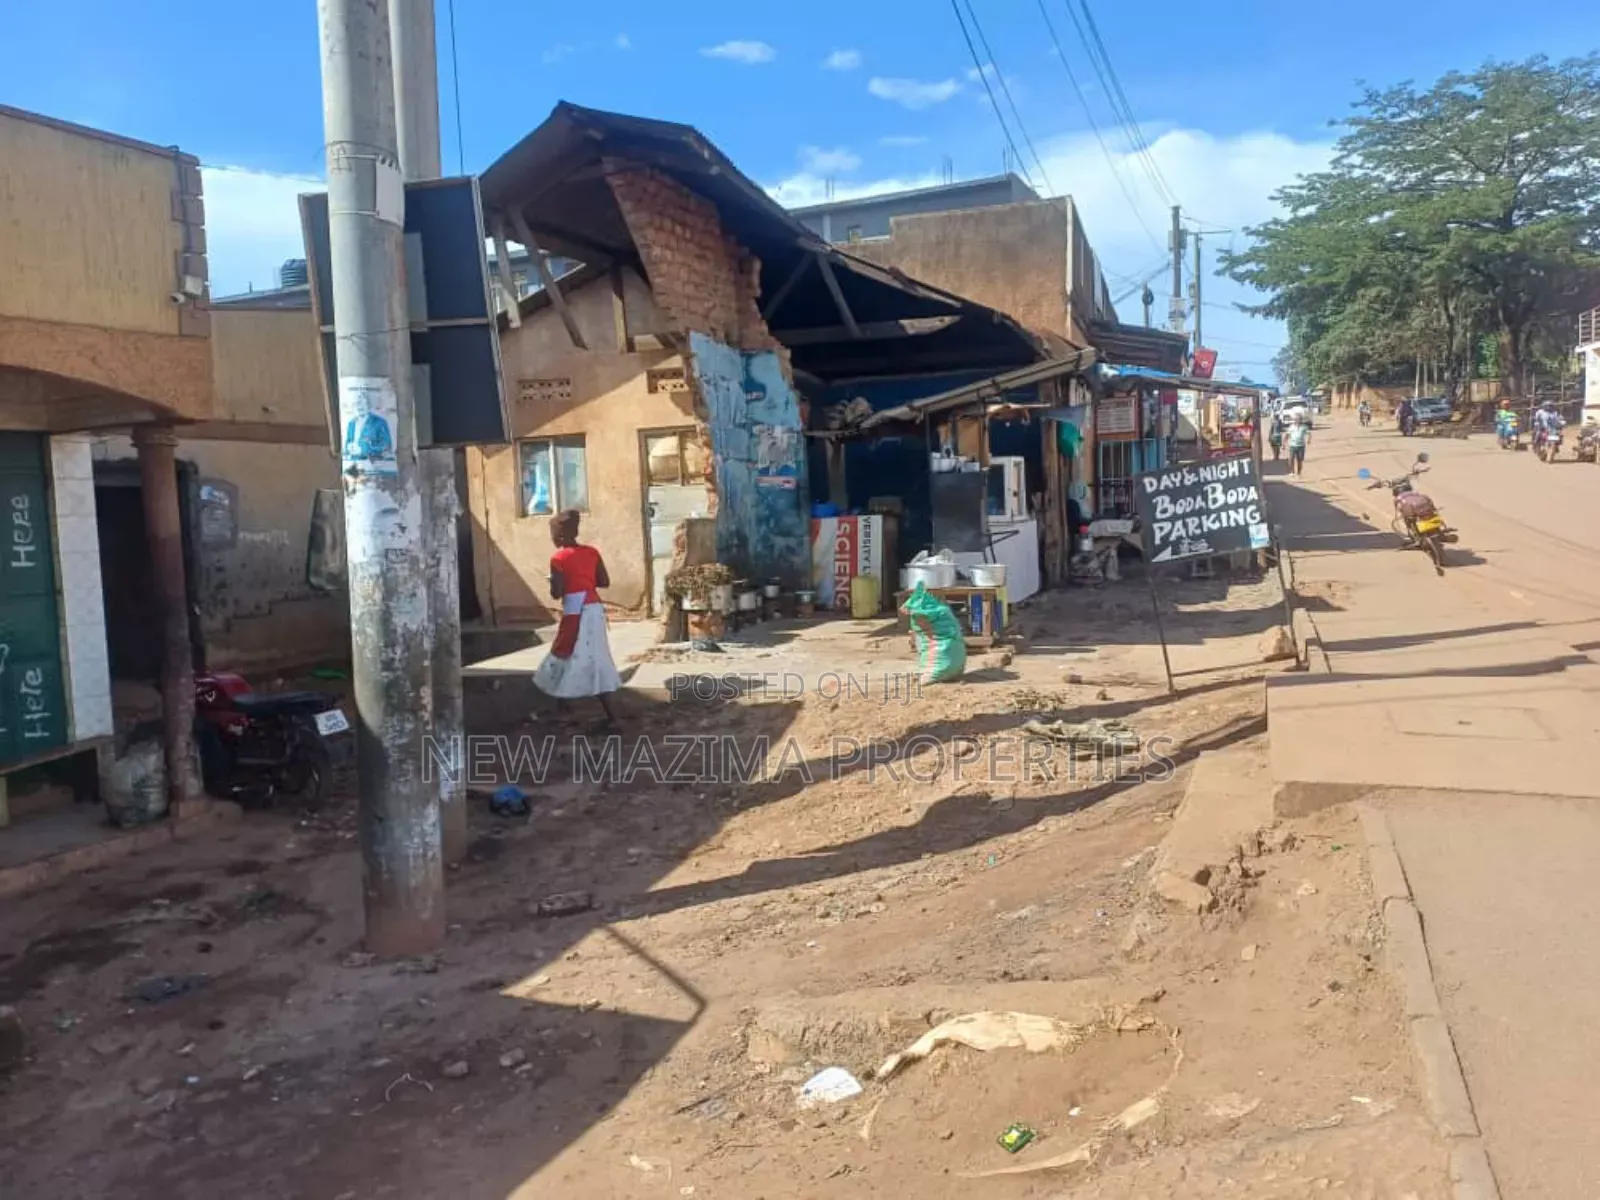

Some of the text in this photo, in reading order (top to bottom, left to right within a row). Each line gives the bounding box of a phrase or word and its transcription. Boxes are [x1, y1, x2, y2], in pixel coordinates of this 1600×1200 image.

[1143, 472, 1182, 493] DAY
[1200, 458, 1251, 483] NIGHT
[1152, 482, 1258, 519] BODA BODA
[1152, 505, 1261, 545] PARKING
